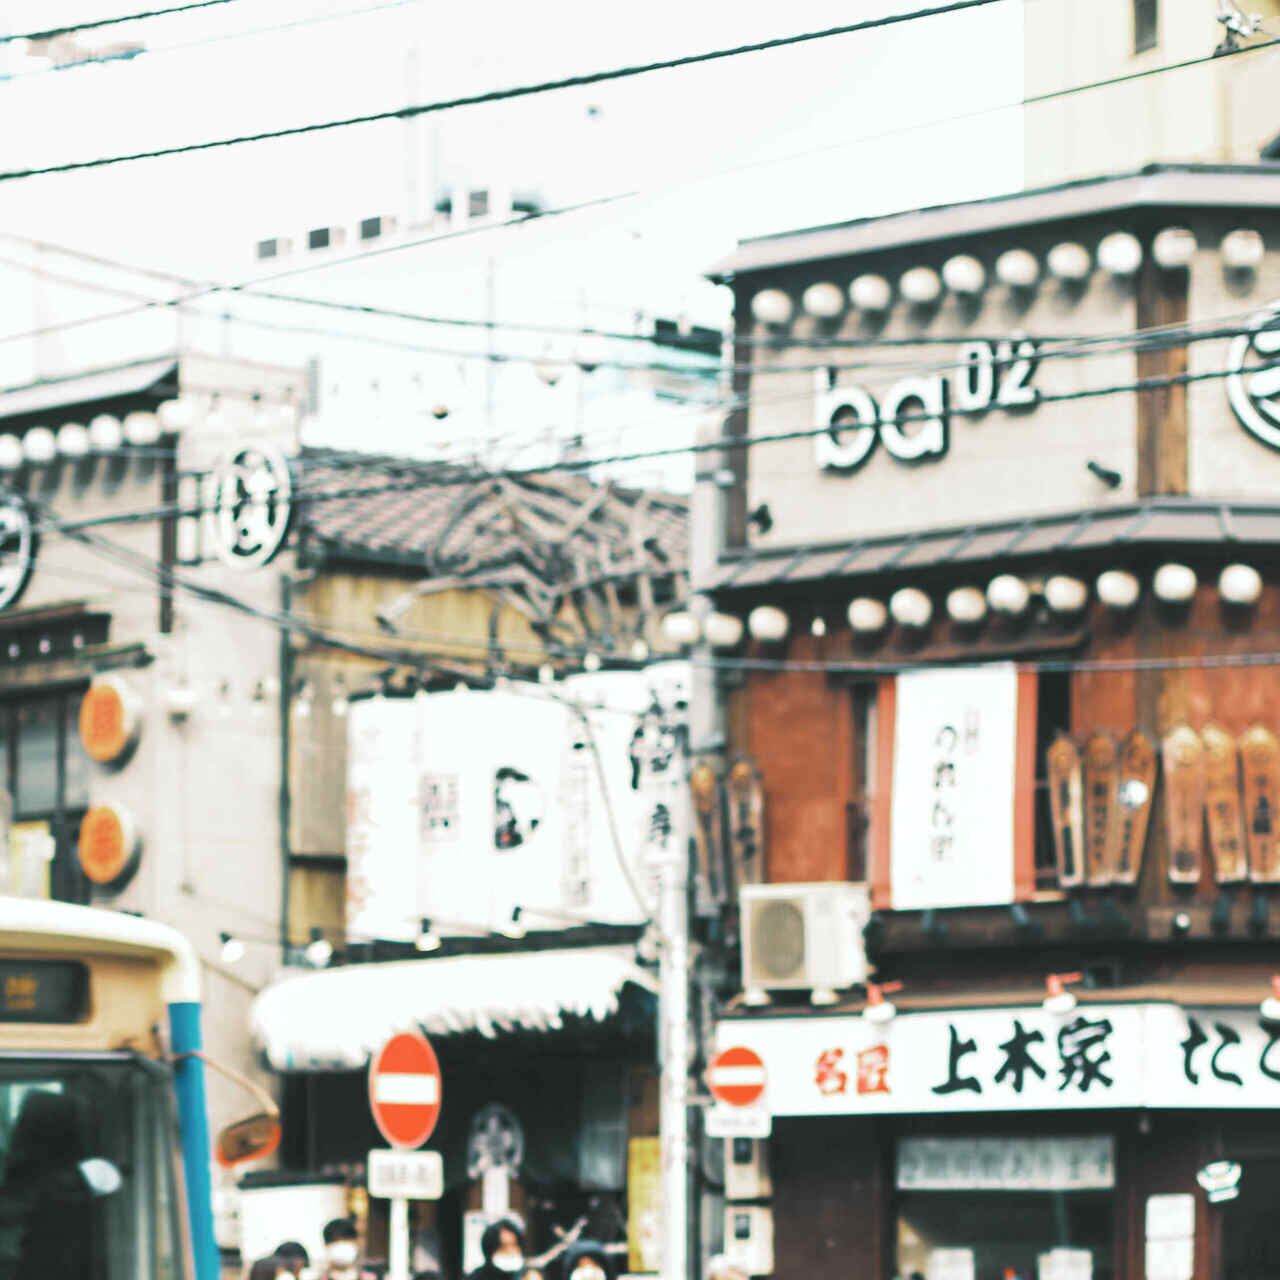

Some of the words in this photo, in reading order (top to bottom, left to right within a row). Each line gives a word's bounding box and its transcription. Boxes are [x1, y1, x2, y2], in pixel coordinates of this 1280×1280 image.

[816, 1045, 892, 1098] 名匠
[932, 1017, 1115, 1095] 上木家
